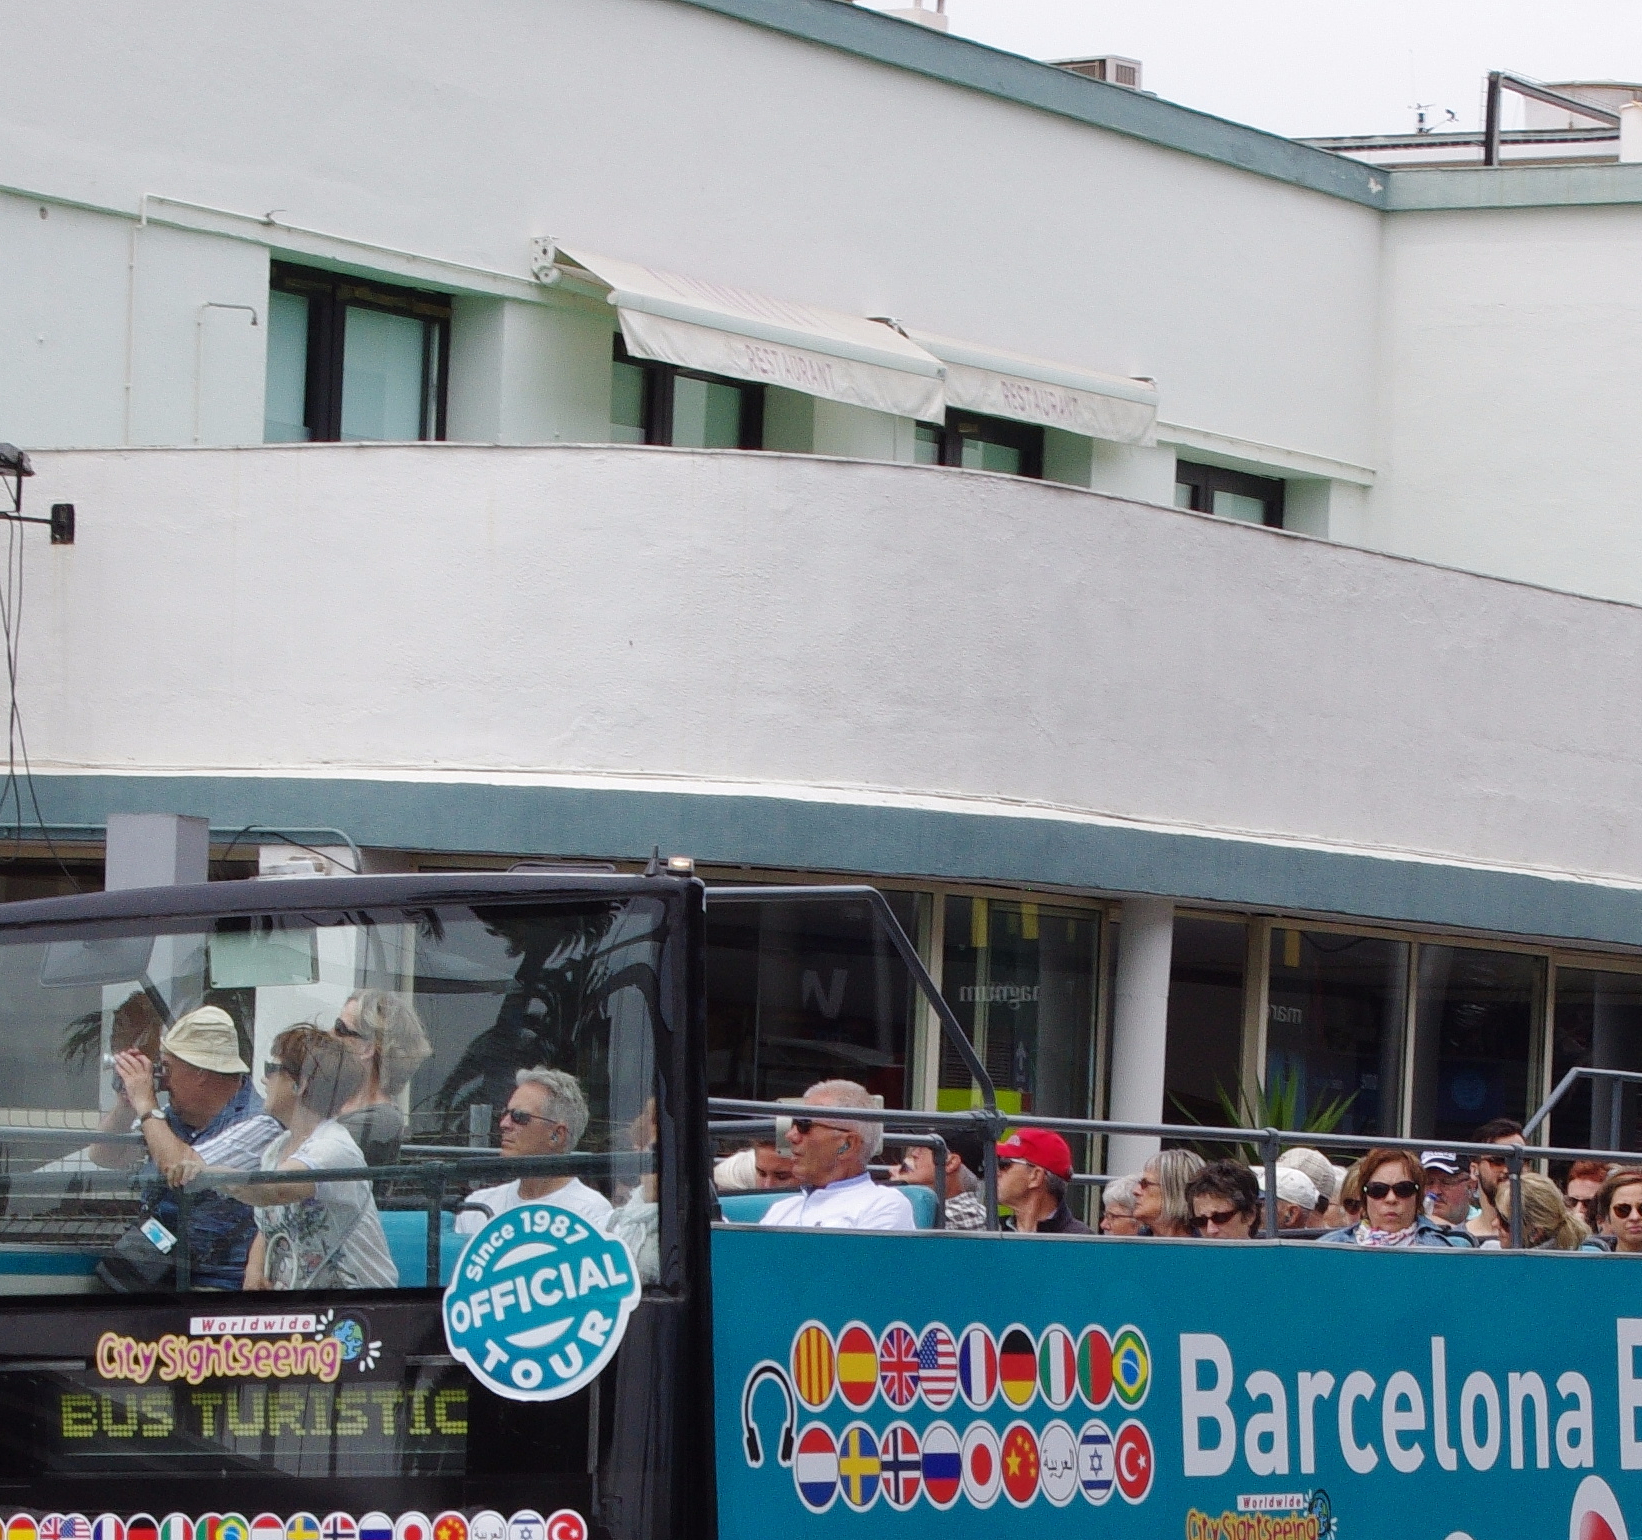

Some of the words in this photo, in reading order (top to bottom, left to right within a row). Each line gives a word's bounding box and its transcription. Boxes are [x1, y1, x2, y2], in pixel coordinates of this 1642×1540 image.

[744, 343, 835, 391] RESTAURANT
[1000, 380, 1078, 417] RESTAURANT
[466, 1224, 515, 1282] Since
[520, 1210, 590, 1244] 1987
[451, 1253, 628, 1333] OFFICIAL
[202, 1316, 313, 1333] Worldwide
[483, 1309, 613, 1389] TOUR
[61, 1392, 174, 1438] BUS
[191, 1388, 469, 1437] TURISTIC
[1179, 1332, 1594, 1478] Barcelona
[1243, 1496, 1302, 1508] Worldwide
